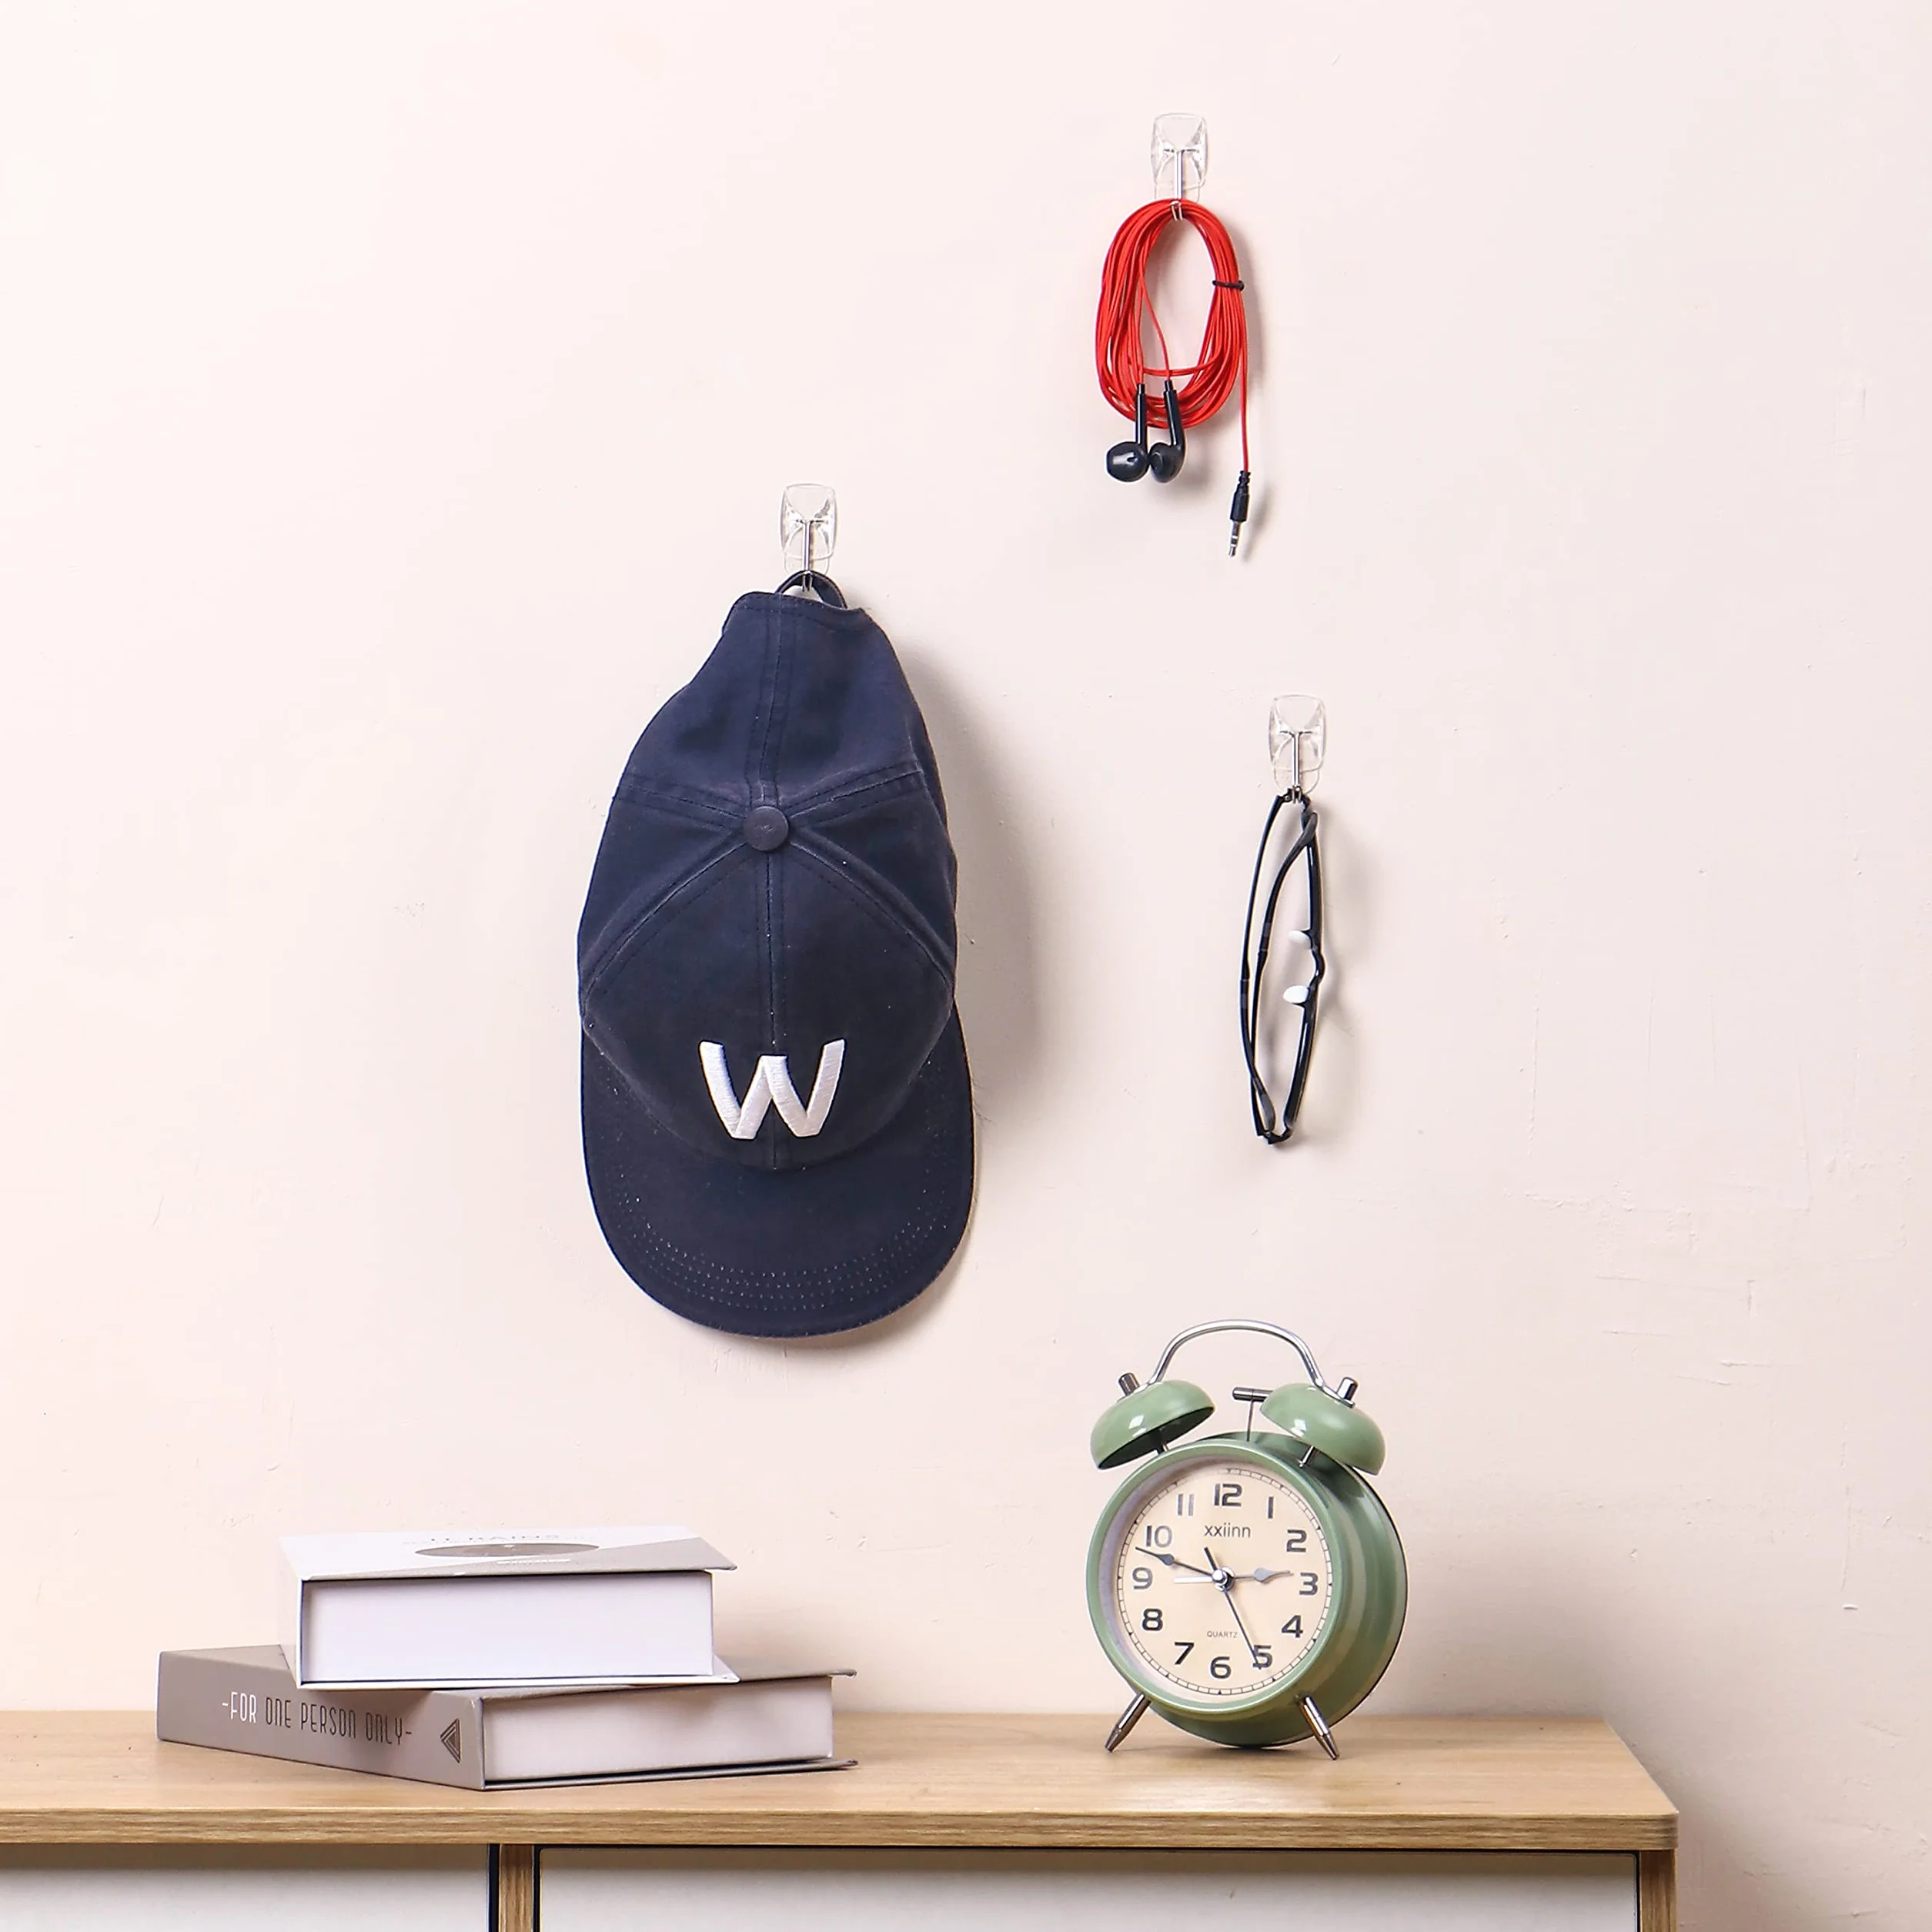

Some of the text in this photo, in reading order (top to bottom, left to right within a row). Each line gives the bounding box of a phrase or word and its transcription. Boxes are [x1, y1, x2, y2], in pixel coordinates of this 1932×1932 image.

[699, 1038, 845, 1140] W
[1177, 1493, 1194, 1516] 11
[1214, 1483, 1243, 1507] 12
[1267, 1496, 1275, 1519] 1
[1145, 1525, 1173, 1548] 10
[1204, 1523, 1252, 1539] xxiinn
[1286, 1529, 1308, 1553] 2
[1131, 1566, 1153, 1590] 9
[1299, 1572, 1319, 1596] 3
[1141, 1608, 1164, 1632] 8
[1281, 1615, 1304, 1639] 4
[1206, 1630, 1238, 1639] QUARTZ
[1174, 1641, 1195, 1666] 7
[1252, 1644, 1274, 1669] 5
[1209, 1656, 1232, 1680] 6
[265, 1696, 292, 1729] ONE
[300, 1702, 357, 1740] PERSON
